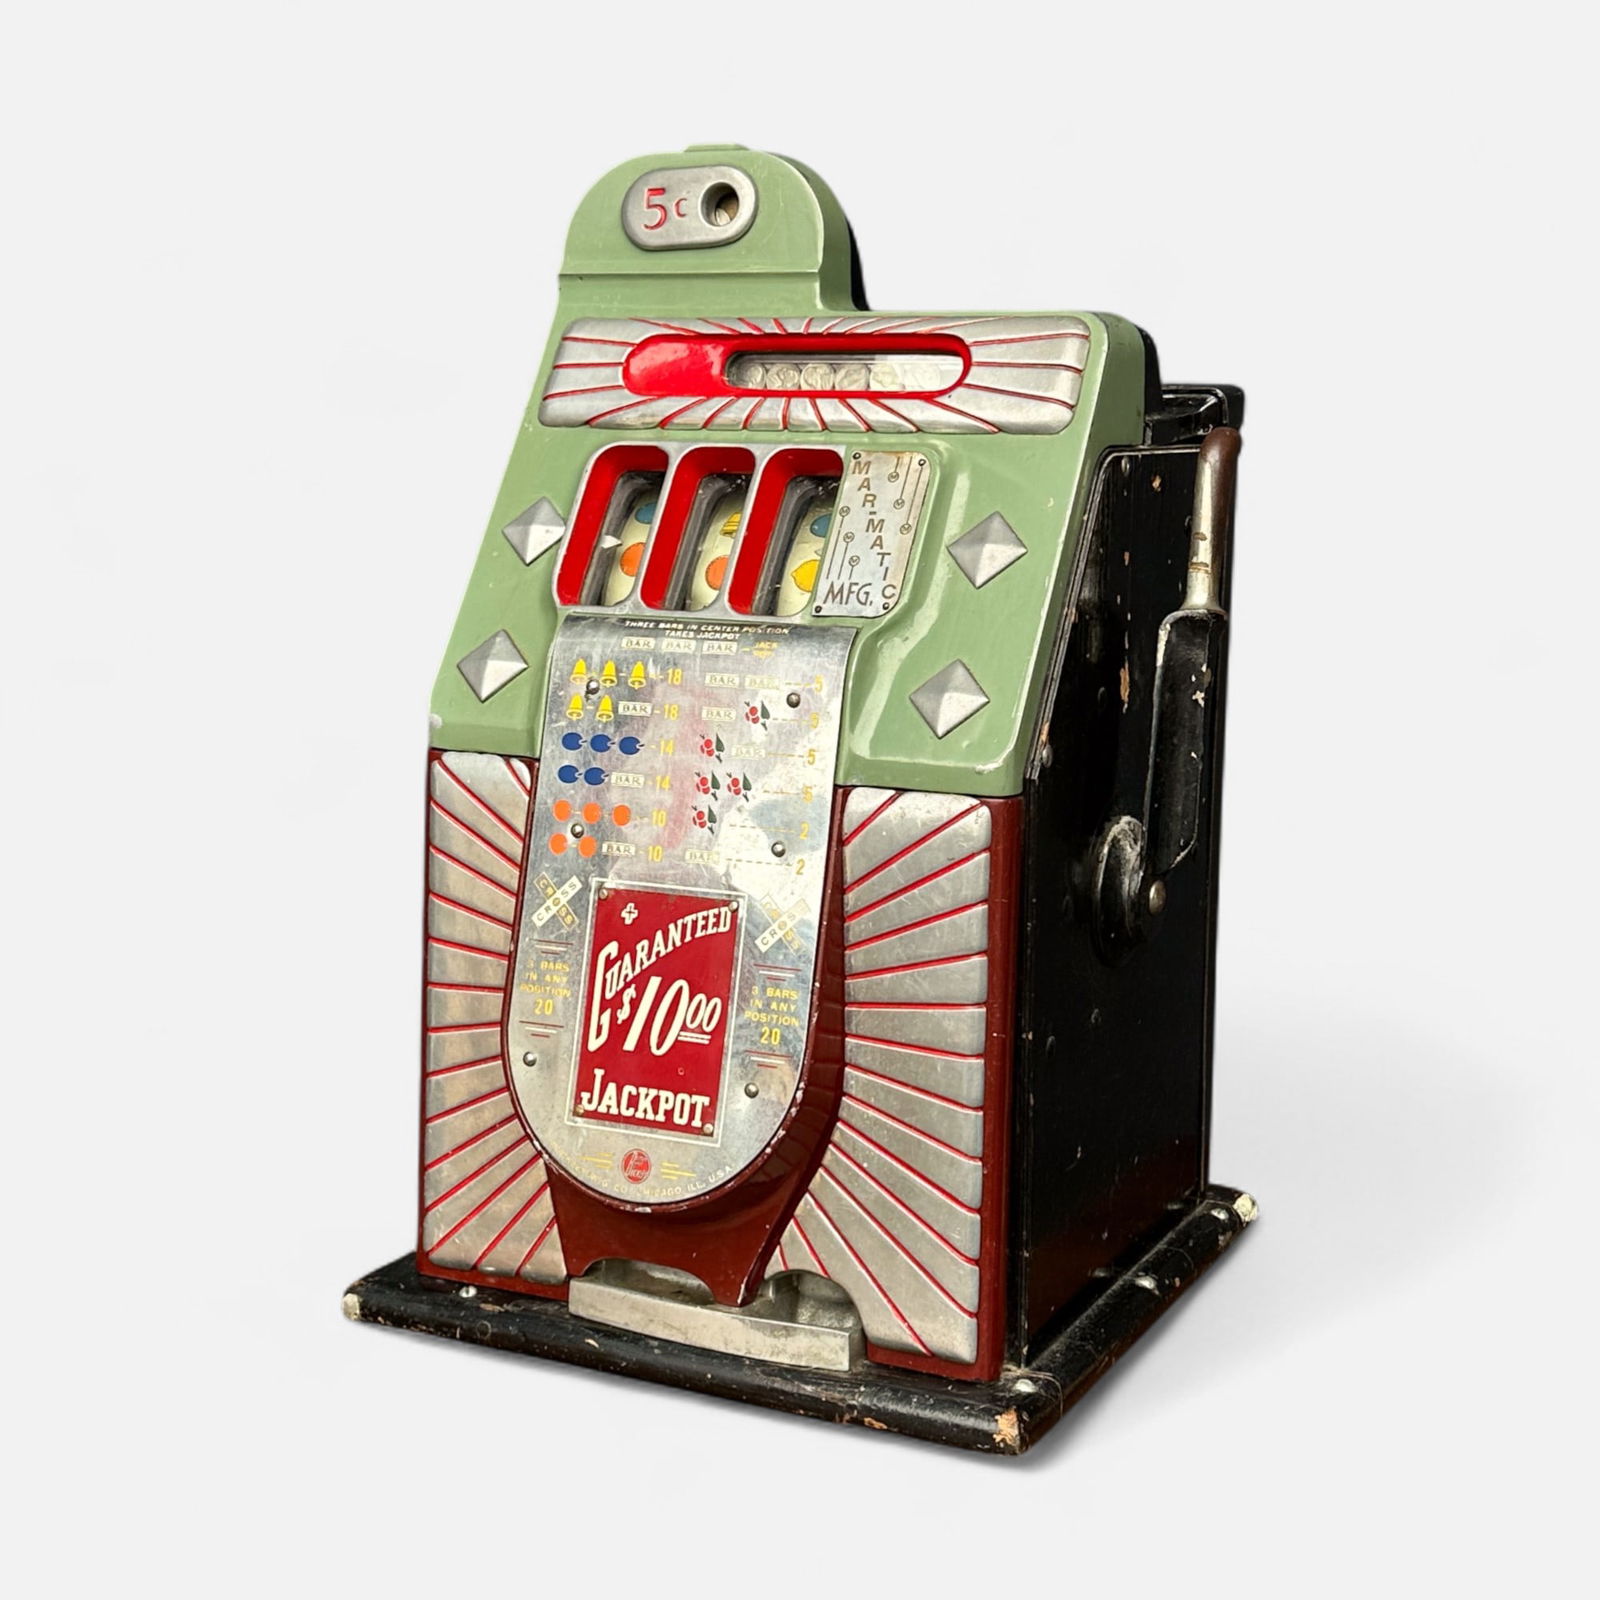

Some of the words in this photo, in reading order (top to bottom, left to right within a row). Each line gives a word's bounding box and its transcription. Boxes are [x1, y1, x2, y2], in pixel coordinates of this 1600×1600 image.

[624, 620, 655, 628] THREE
[658, 622, 684, 630] BARS
[701, 625, 739, 633] CENTER
[742, 626, 789, 635] POSITION
[665, 630, 695, 638] TAKES
[697, 632, 740, 640] JACKPOT
[624, 638, 652, 648] BAR
[664, 640, 692, 650] BAR
[706, 643, 734, 652] BAR
[667, 669, 682, 684] 18
[709, 675, 737, 685] BAR
[622, 702, 648, 714] BAR
[663, 704, 678, 720] 18
[705, 709, 734, 719] BAR
[660, 740, 674, 755] 14
[615, 775, 641, 785] BAR
[655, 775, 670, 790] 14
[651, 810, 667, 827] 10
[800, 823, 809, 838] 2
[606, 844, 631, 855] BAR
[647, 846, 662, 861] 10
[796, 859, 805, 875] 2
[541, 960, 570, 971] BARS
[544, 974, 567, 984] ANY
[520, 984, 571, 997] POSITION
[766, 987, 798, 1000] BARS
[535, 1000, 553, 1015] 20
[750, 1000, 763, 1008] IN
[771, 1003, 796, 1012] ANY
[744, 1011, 799, 1026] POSITION
[761, 1027, 781, 1045] 20
[580, 1068, 710, 1128] JACKPOT
